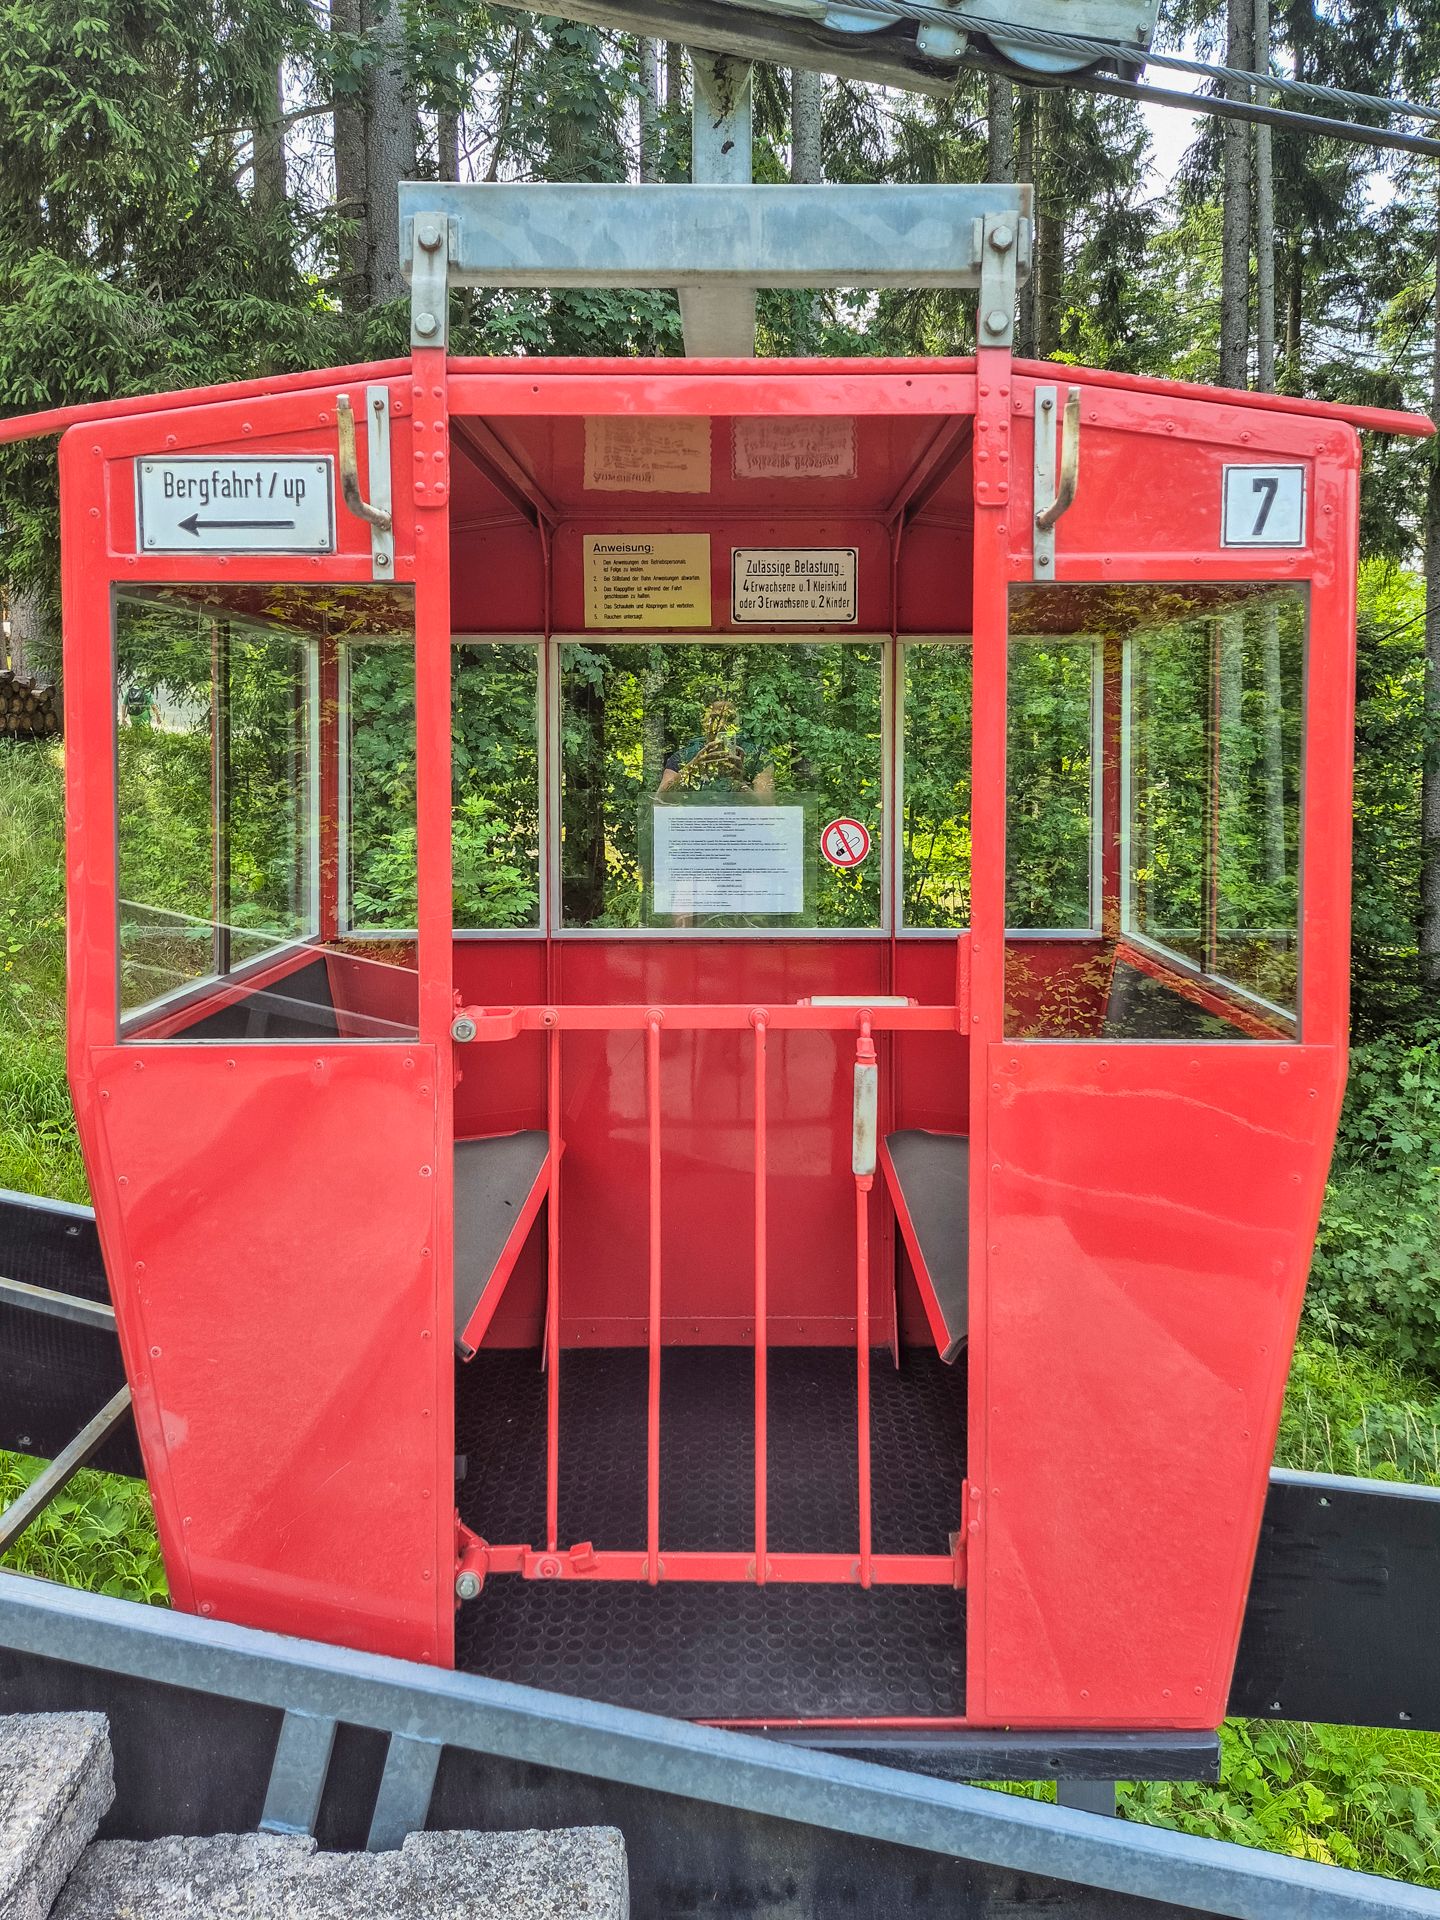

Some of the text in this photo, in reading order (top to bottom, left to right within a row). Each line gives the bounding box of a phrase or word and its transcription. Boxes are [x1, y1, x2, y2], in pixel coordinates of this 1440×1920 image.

[163, 470, 263, 506] Bergfahrt
[283, 477, 306, 506] up
[1252, 478, 1279, 535] 7
[593, 543, 654, 554] Anweisung:
[746, 559, 845, 576] Zulässige Belastung:
[743, 579, 749, 592] 4
[751, 581, 795, 592] Erwachsene
[813, 580, 847, 592] Kleinkind
[739, 598, 756, 608] oder
[758, 596, 764, 608] 3
[765, 597, 809, 608] Erwachsene
[819, 595, 825, 607] 2
[826, 597, 850, 608] Kinder
